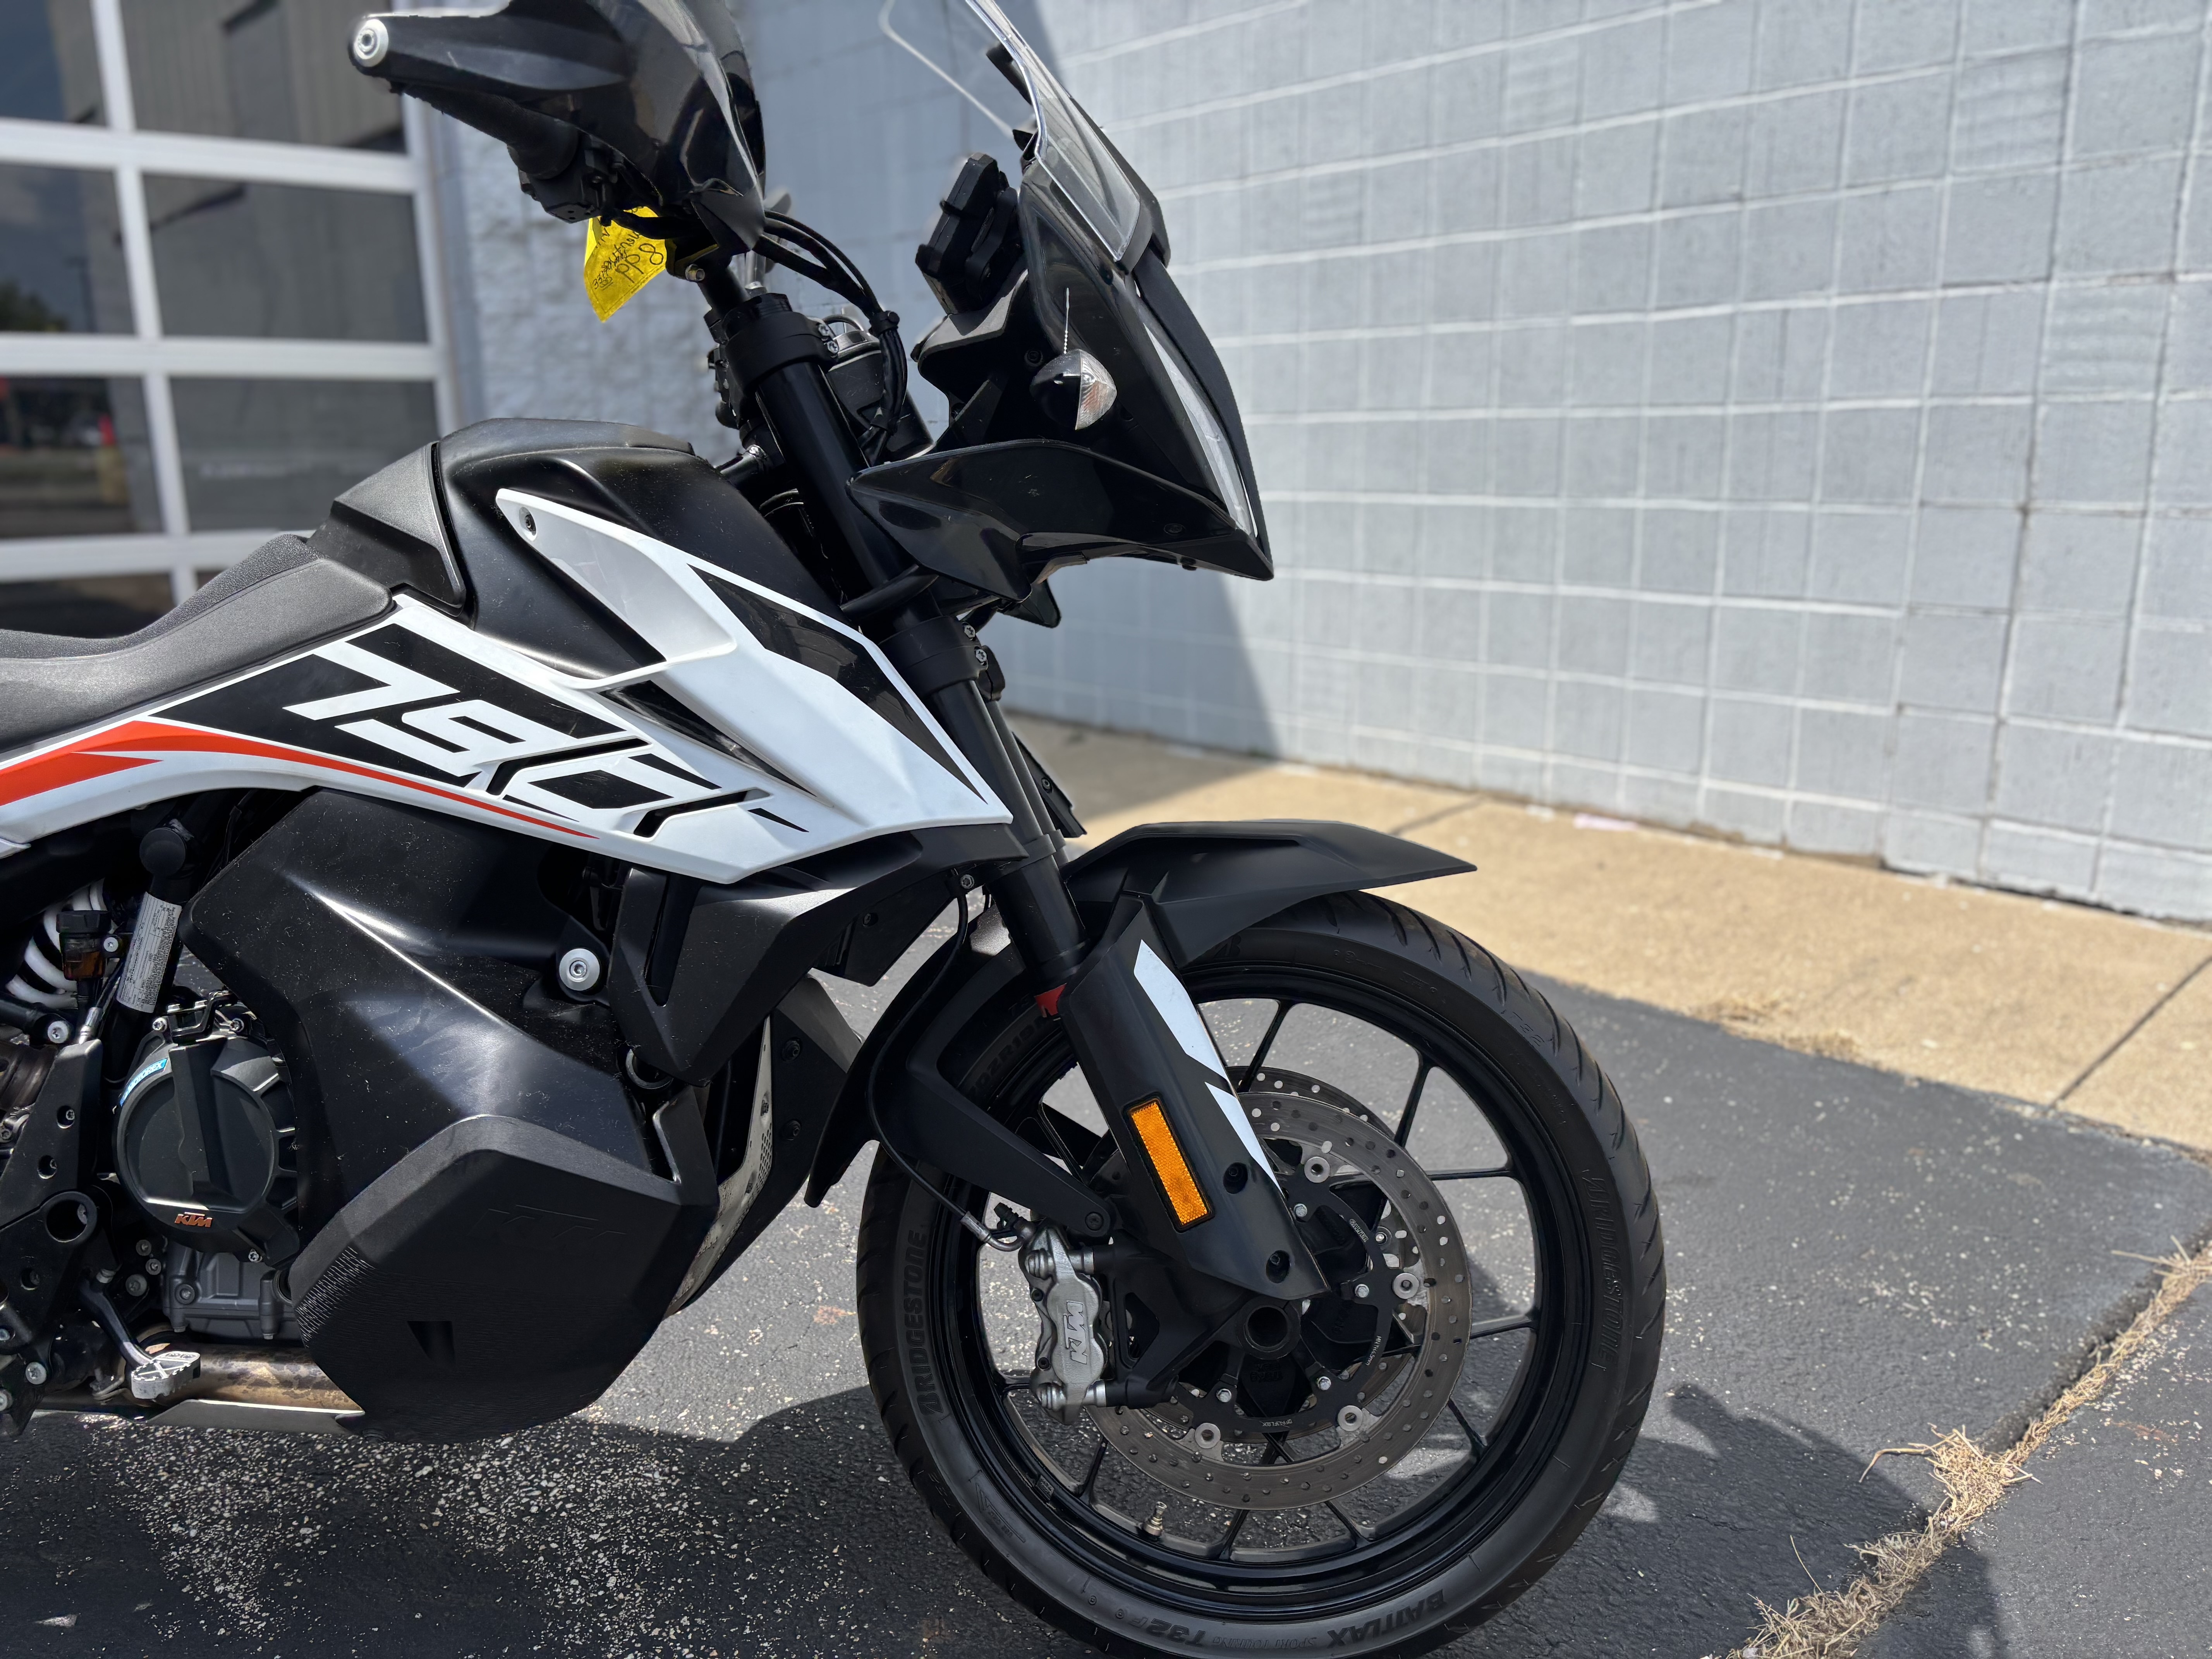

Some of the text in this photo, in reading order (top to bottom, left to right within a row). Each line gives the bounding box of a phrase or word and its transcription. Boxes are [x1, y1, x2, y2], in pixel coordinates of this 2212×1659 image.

[282, 641, 707, 824] 790
[174, 1211, 212, 1228] KTM
[1349, 1217, 1370, 1243] GALFER
[903, 1229, 944, 1415] BRIDGESTONE
[1064, 1301, 1087, 1364] KTM
[1151, 1618, 1206, 1647] T32
[1327, 1589, 1447, 1649] BATTLAX
[1275, 1636, 1317, 1650] SPORT
